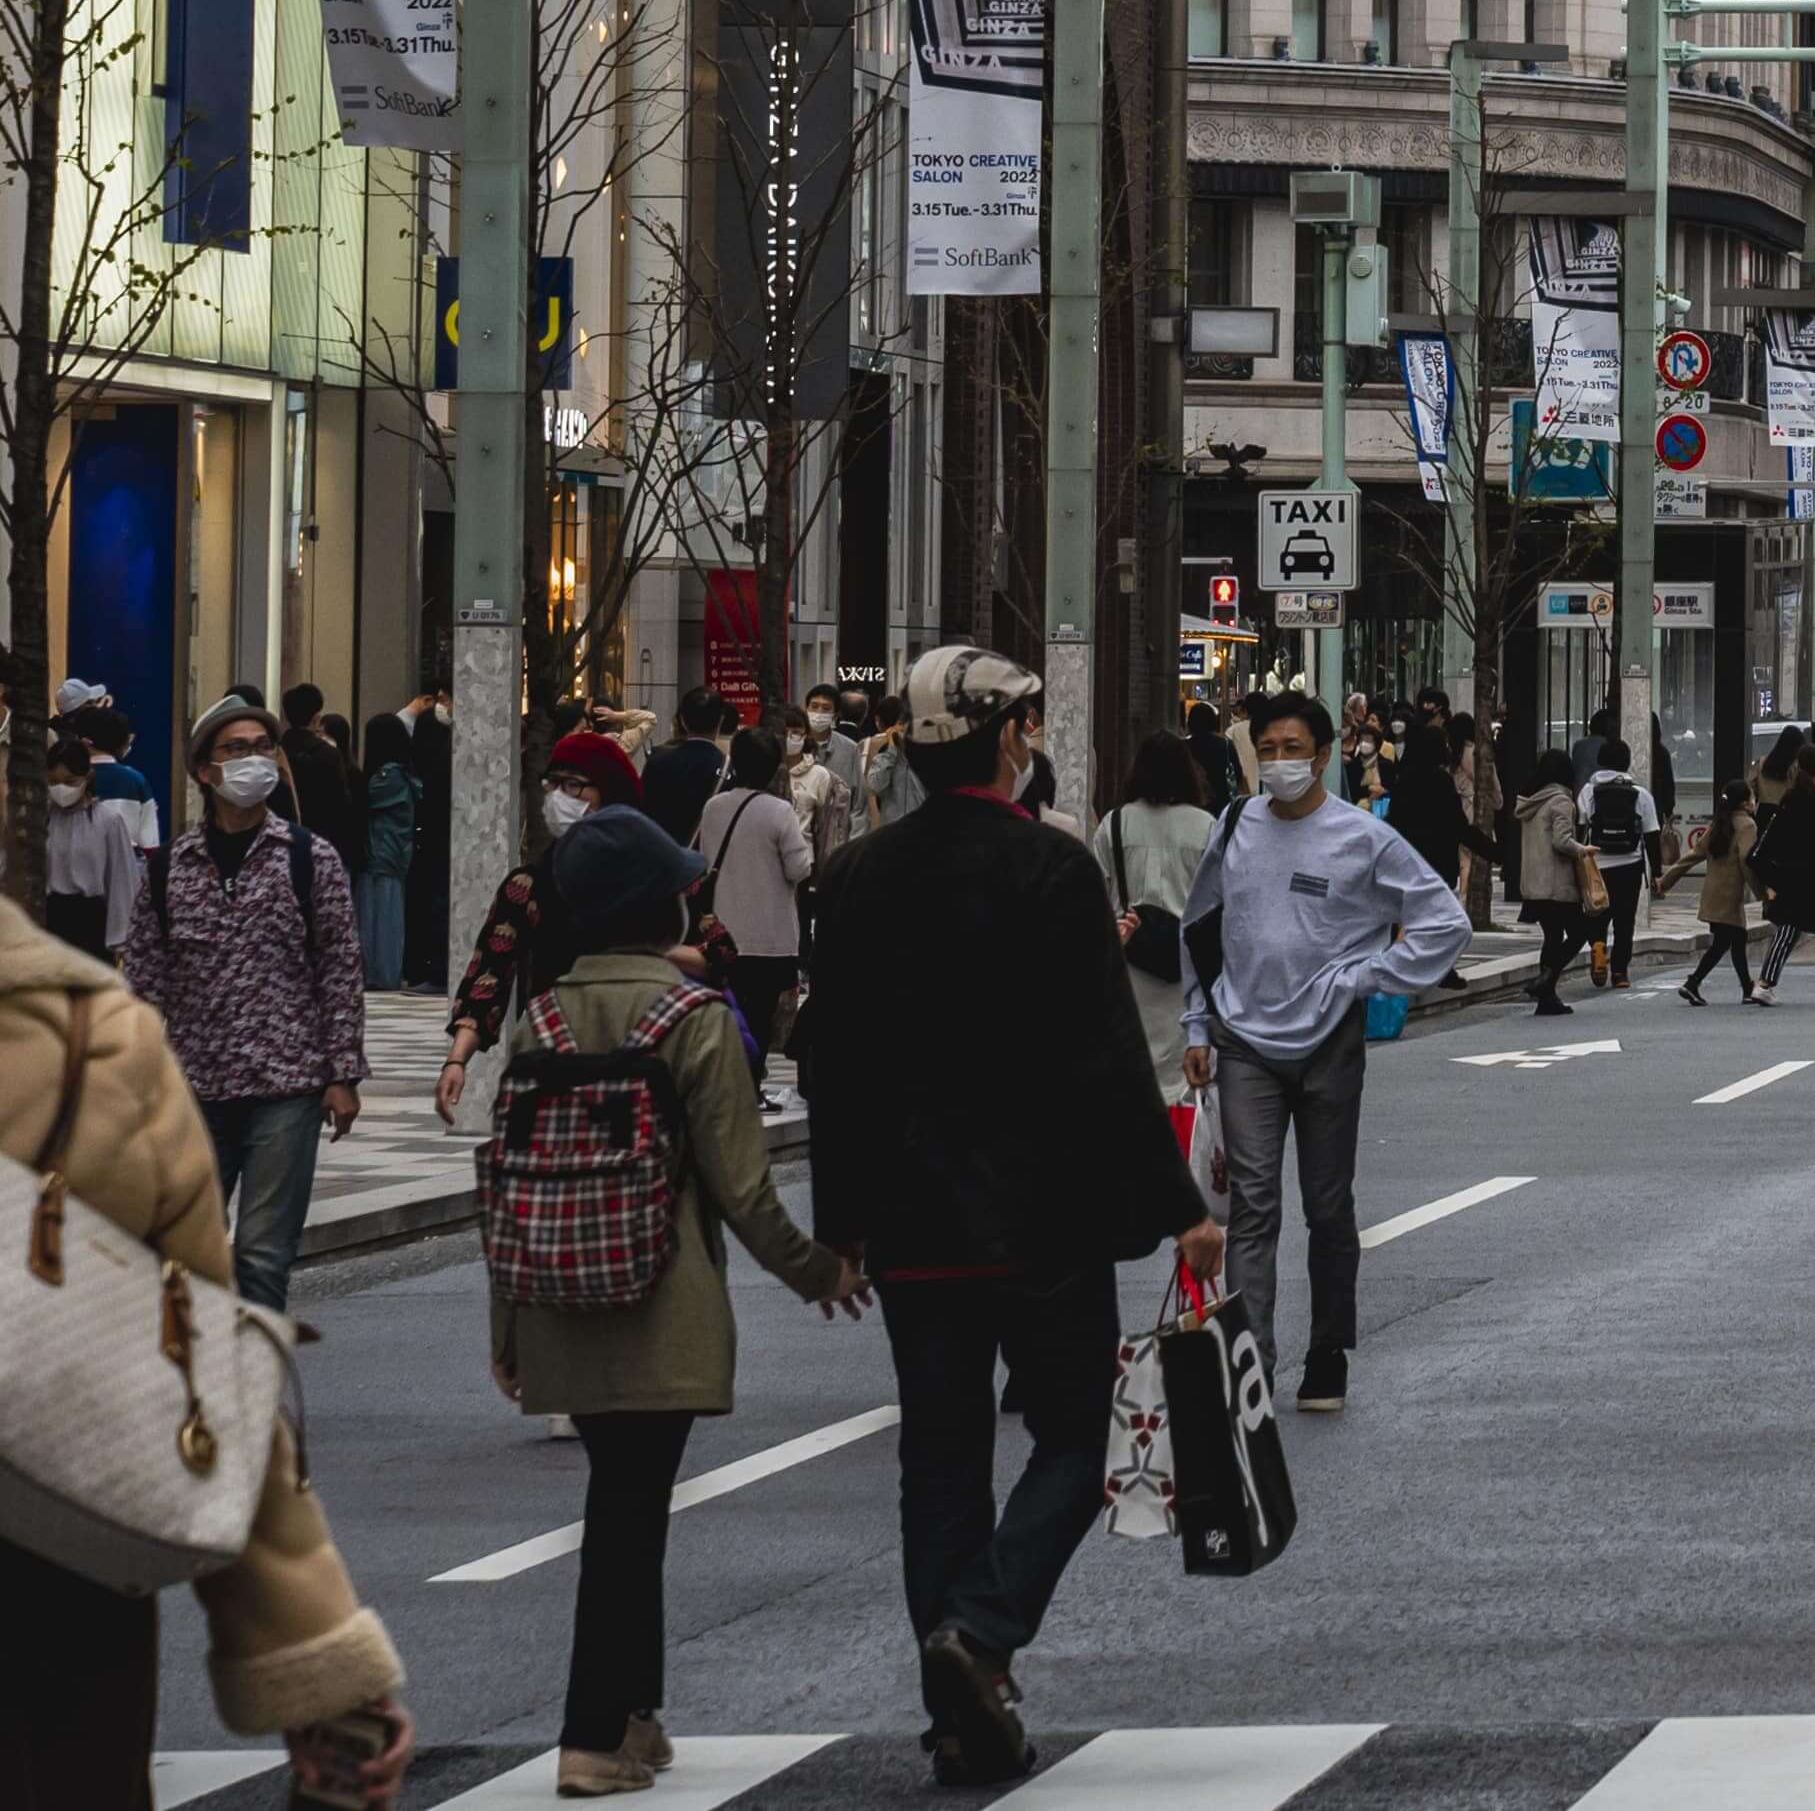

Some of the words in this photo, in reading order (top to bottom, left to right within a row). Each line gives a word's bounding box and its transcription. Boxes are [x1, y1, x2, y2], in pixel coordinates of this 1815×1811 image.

[966, 18, 1029, 36] GINZA
[921, 45, 1002, 70] GINZA
[912, 155, 964, 167] TOKYO
[969, 155, 1037, 168] CREATIVE
[913, 171, 963, 183] SALON
[1000, 171, 1037, 183] 2022
[945, 246, 1034, 267] SoftBank
[1537, 347, 1568, 357] TOKYO
[1270, 500, 1346, 523] TAXI
[1664, 596, 1698, 607] 銀座駅
